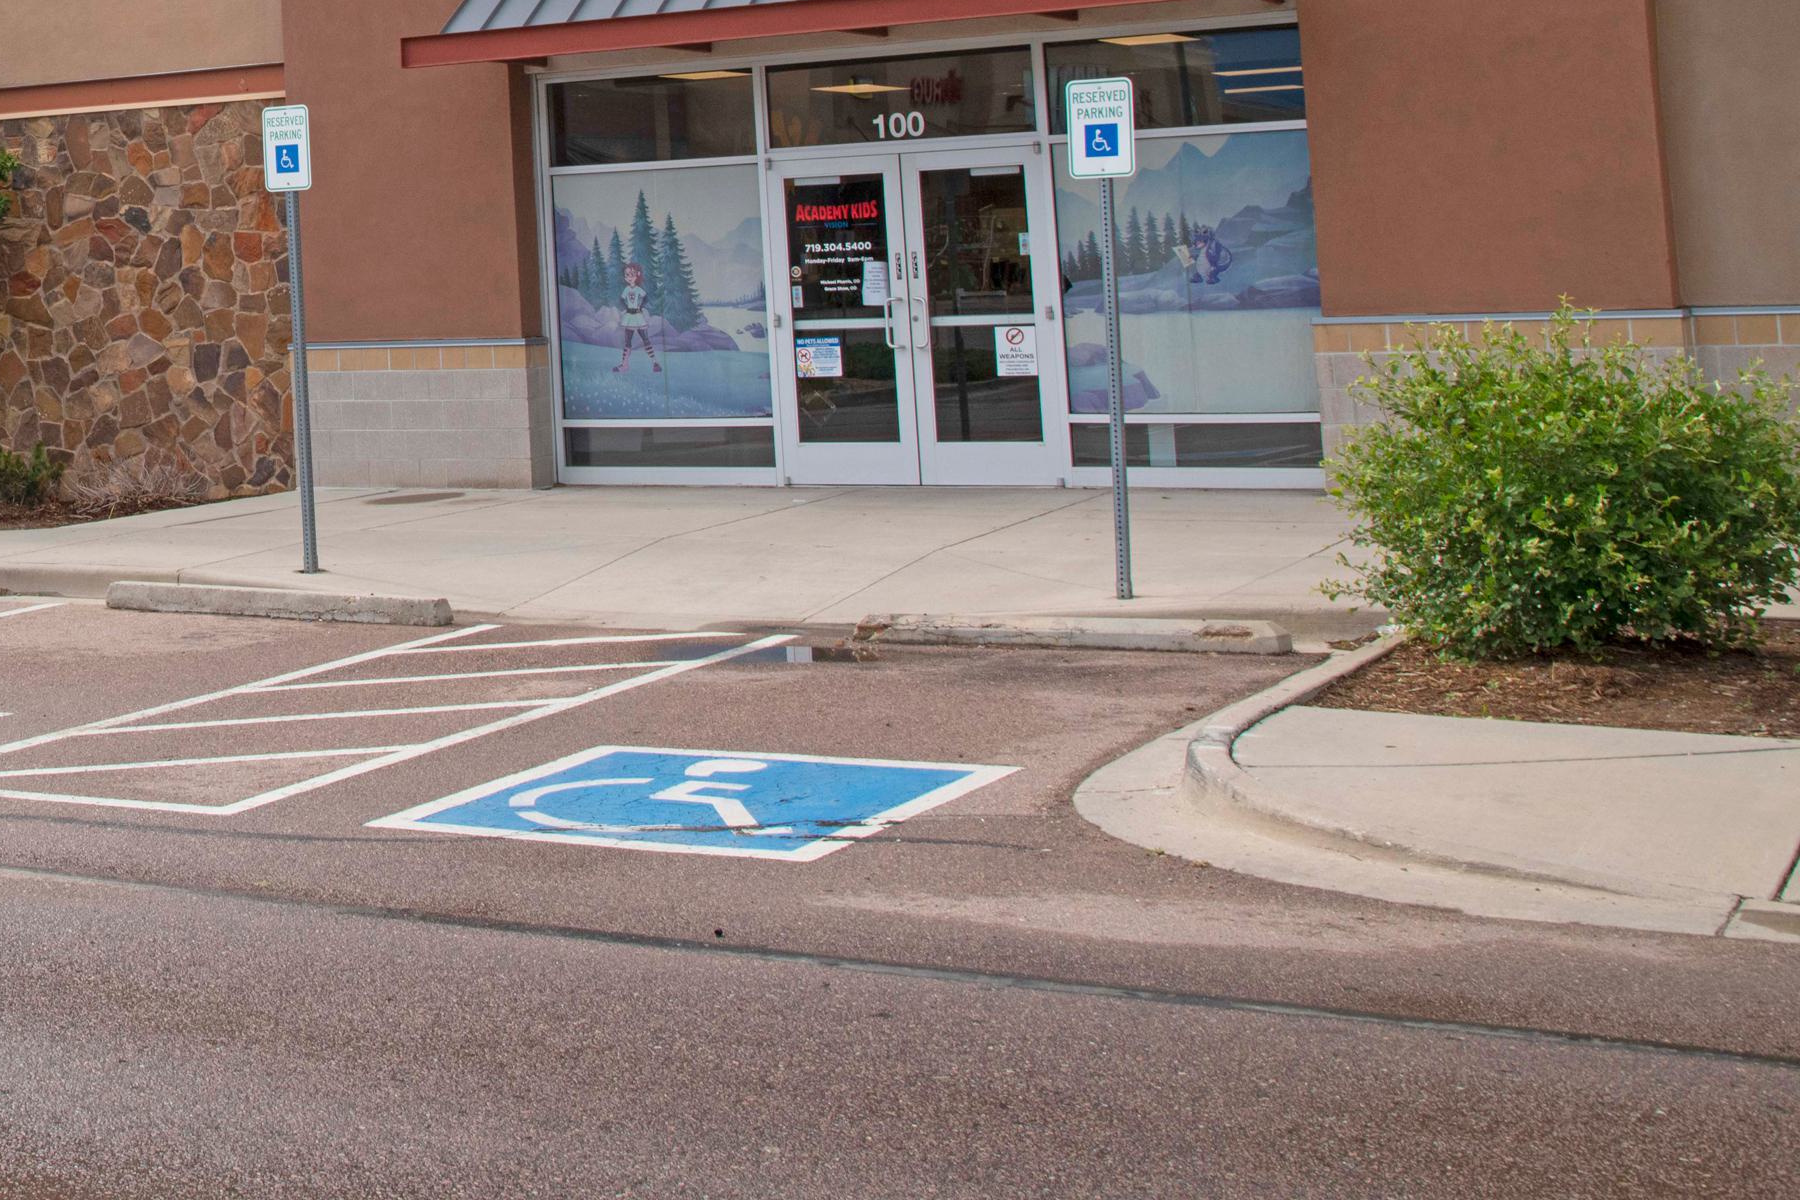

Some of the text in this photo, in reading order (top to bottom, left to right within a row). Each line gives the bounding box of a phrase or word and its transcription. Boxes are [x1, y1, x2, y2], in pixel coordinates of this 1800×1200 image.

[1072, 90, 1126, 104] RESERVED
[1077, 106, 1123, 120] PARKING
[266, 116, 304, 128] RESERVED
[872, 111, 925, 139] 100
[270, 129, 302, 141] PARKING
[795, 200, 878, 222] ACADEMY KIDS
[824, 221, 849, 229] VISION
[805, 241, 872, 253] 719.304.5400
